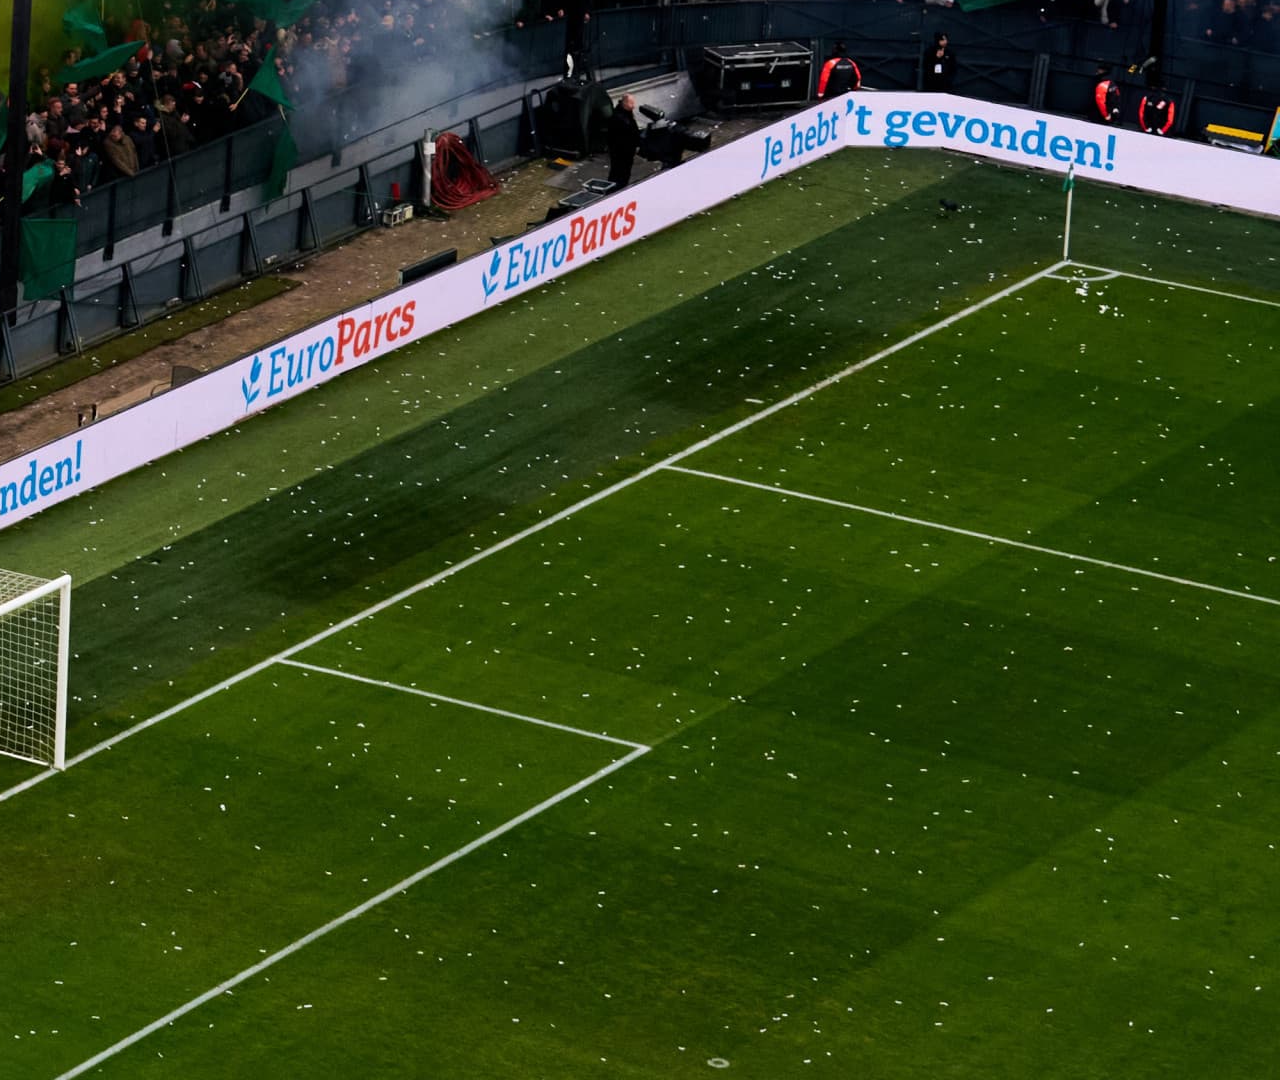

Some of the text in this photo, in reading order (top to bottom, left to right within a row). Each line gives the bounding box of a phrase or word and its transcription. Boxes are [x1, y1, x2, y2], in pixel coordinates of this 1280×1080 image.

[761, 136, 783, 177] Je
[789, 111, 839, 159] hebt
[883, 110, 1116, 172] gevonden!
[504, 201, 637, 291] EuroParcs
[267, 300, 416, 397] EuroParcs
